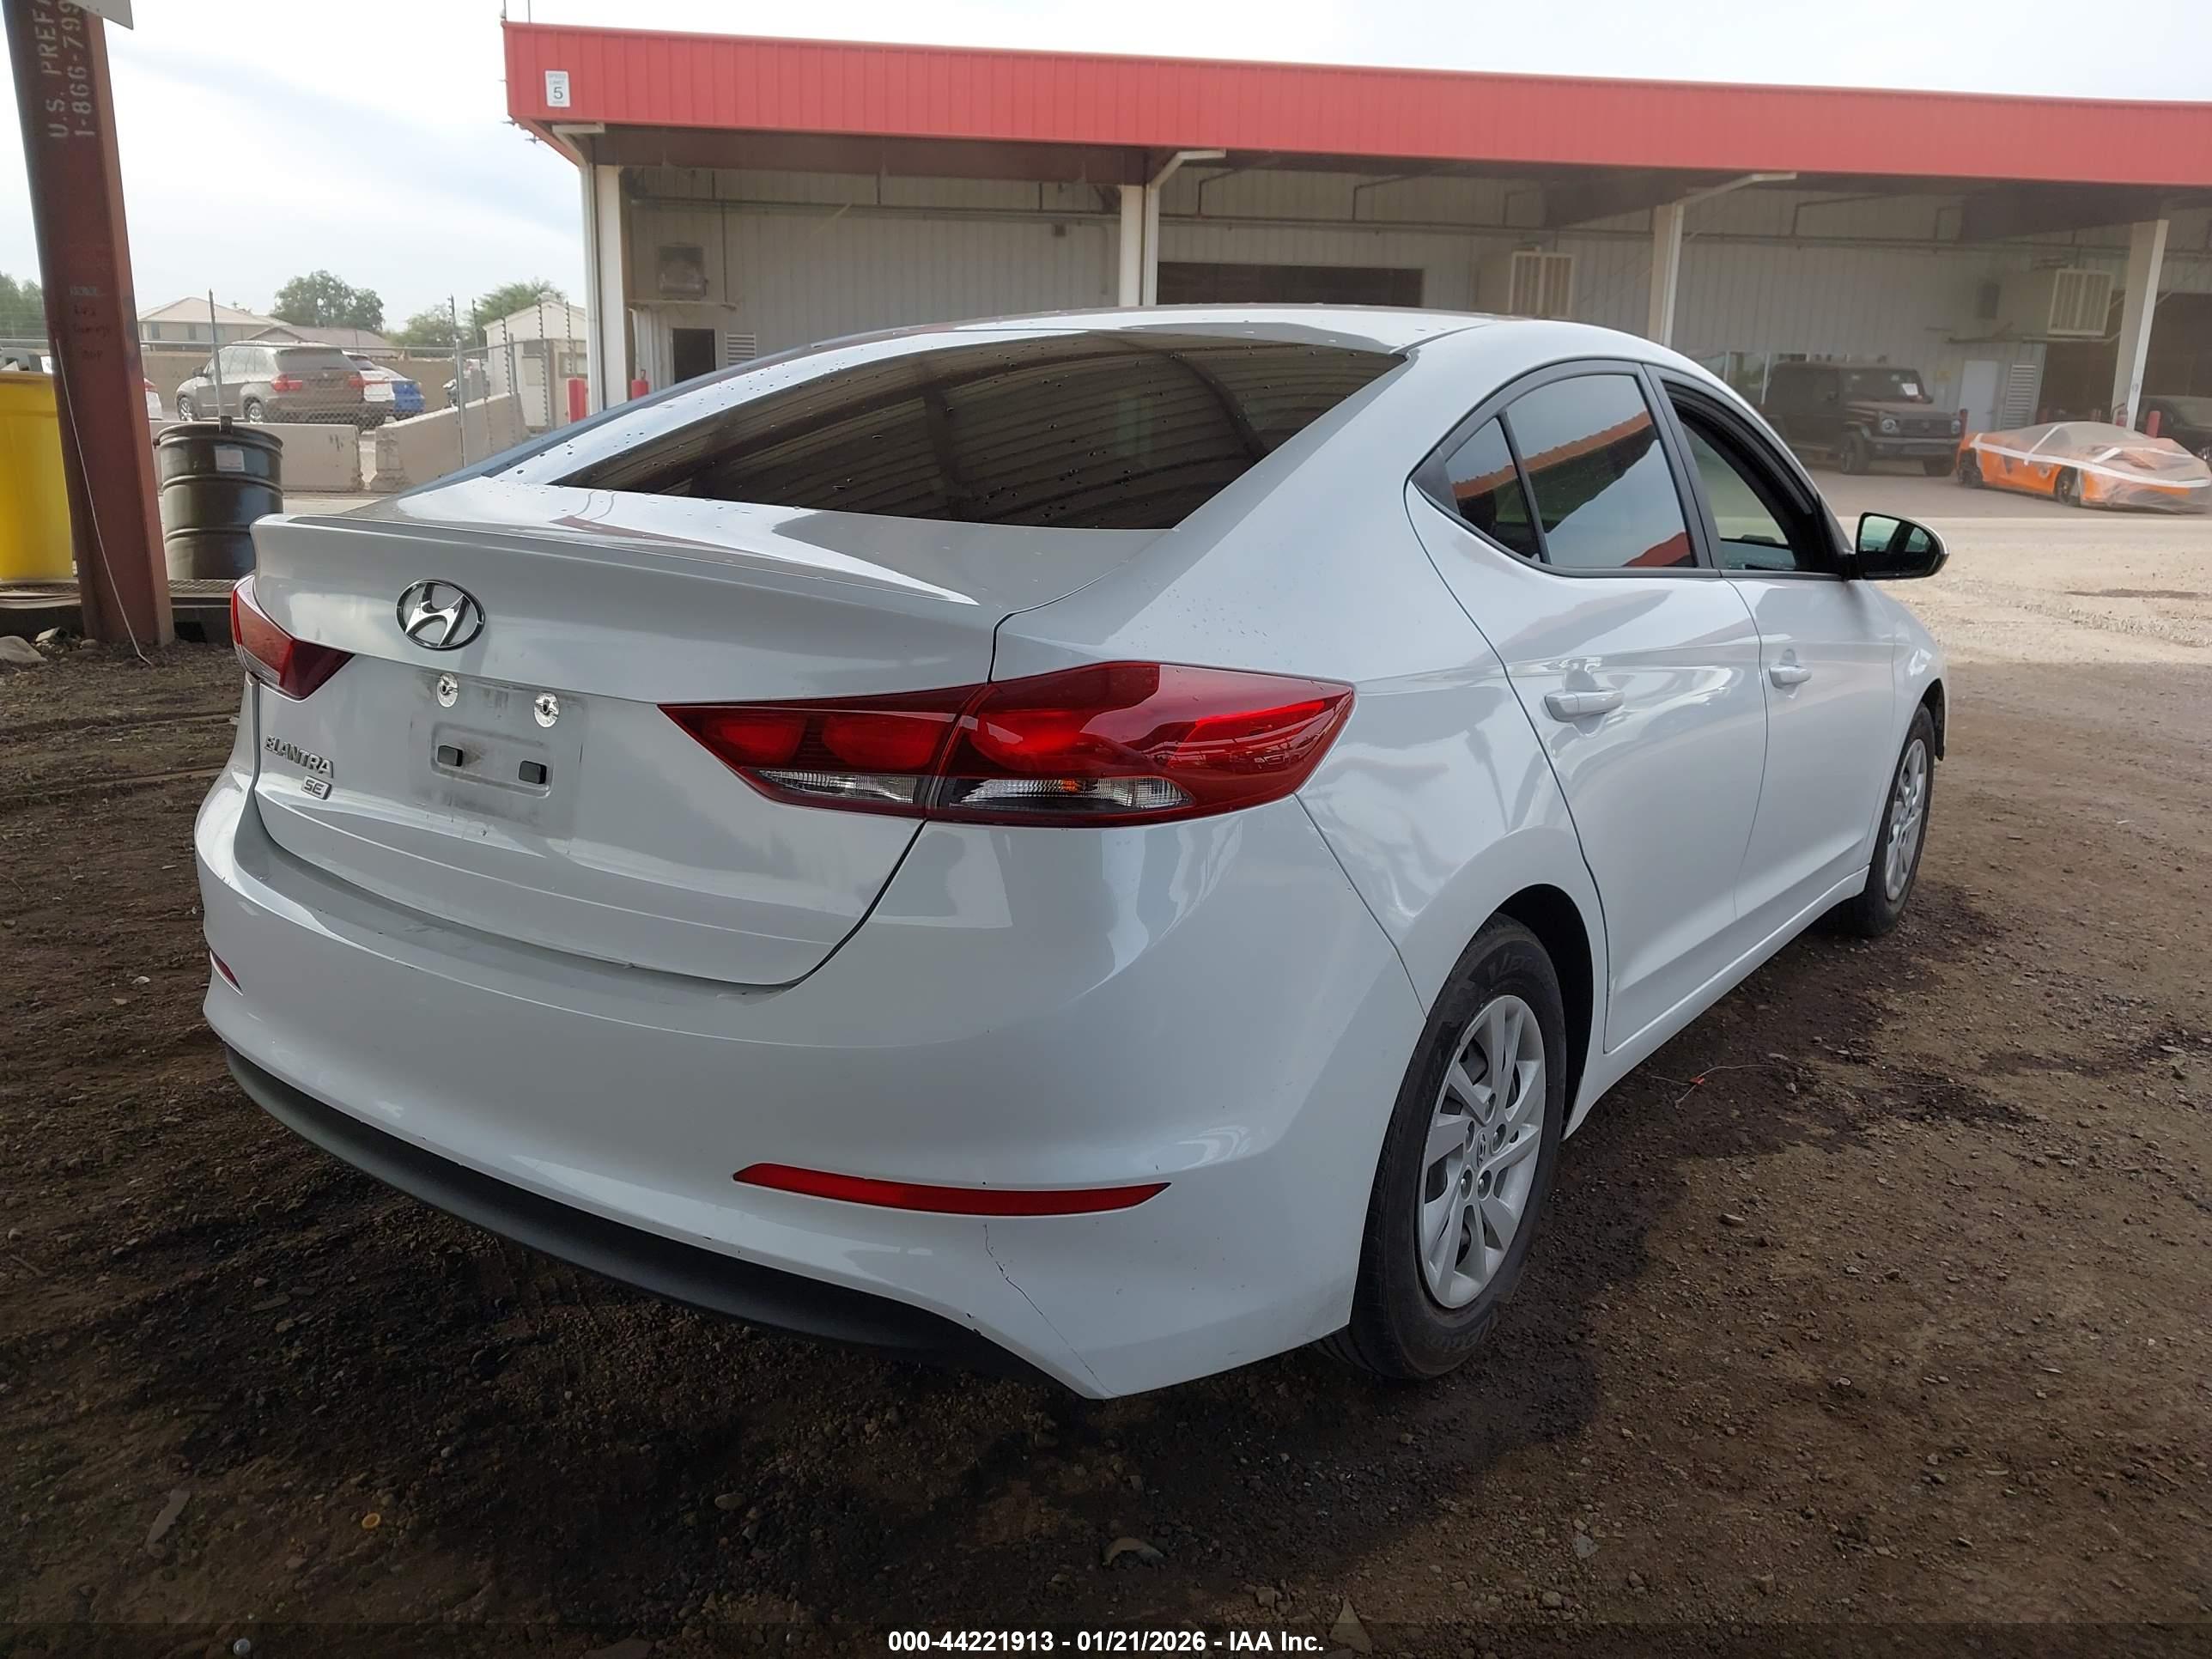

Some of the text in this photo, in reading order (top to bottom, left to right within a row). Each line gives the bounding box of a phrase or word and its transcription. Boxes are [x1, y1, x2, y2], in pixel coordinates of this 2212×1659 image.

[554, 86, 563, 100] 5
[45, 91, 69, 138] U.S.
[264, 734, 333, 778] ELANTRA
[303, 777, 327, 797] SE
